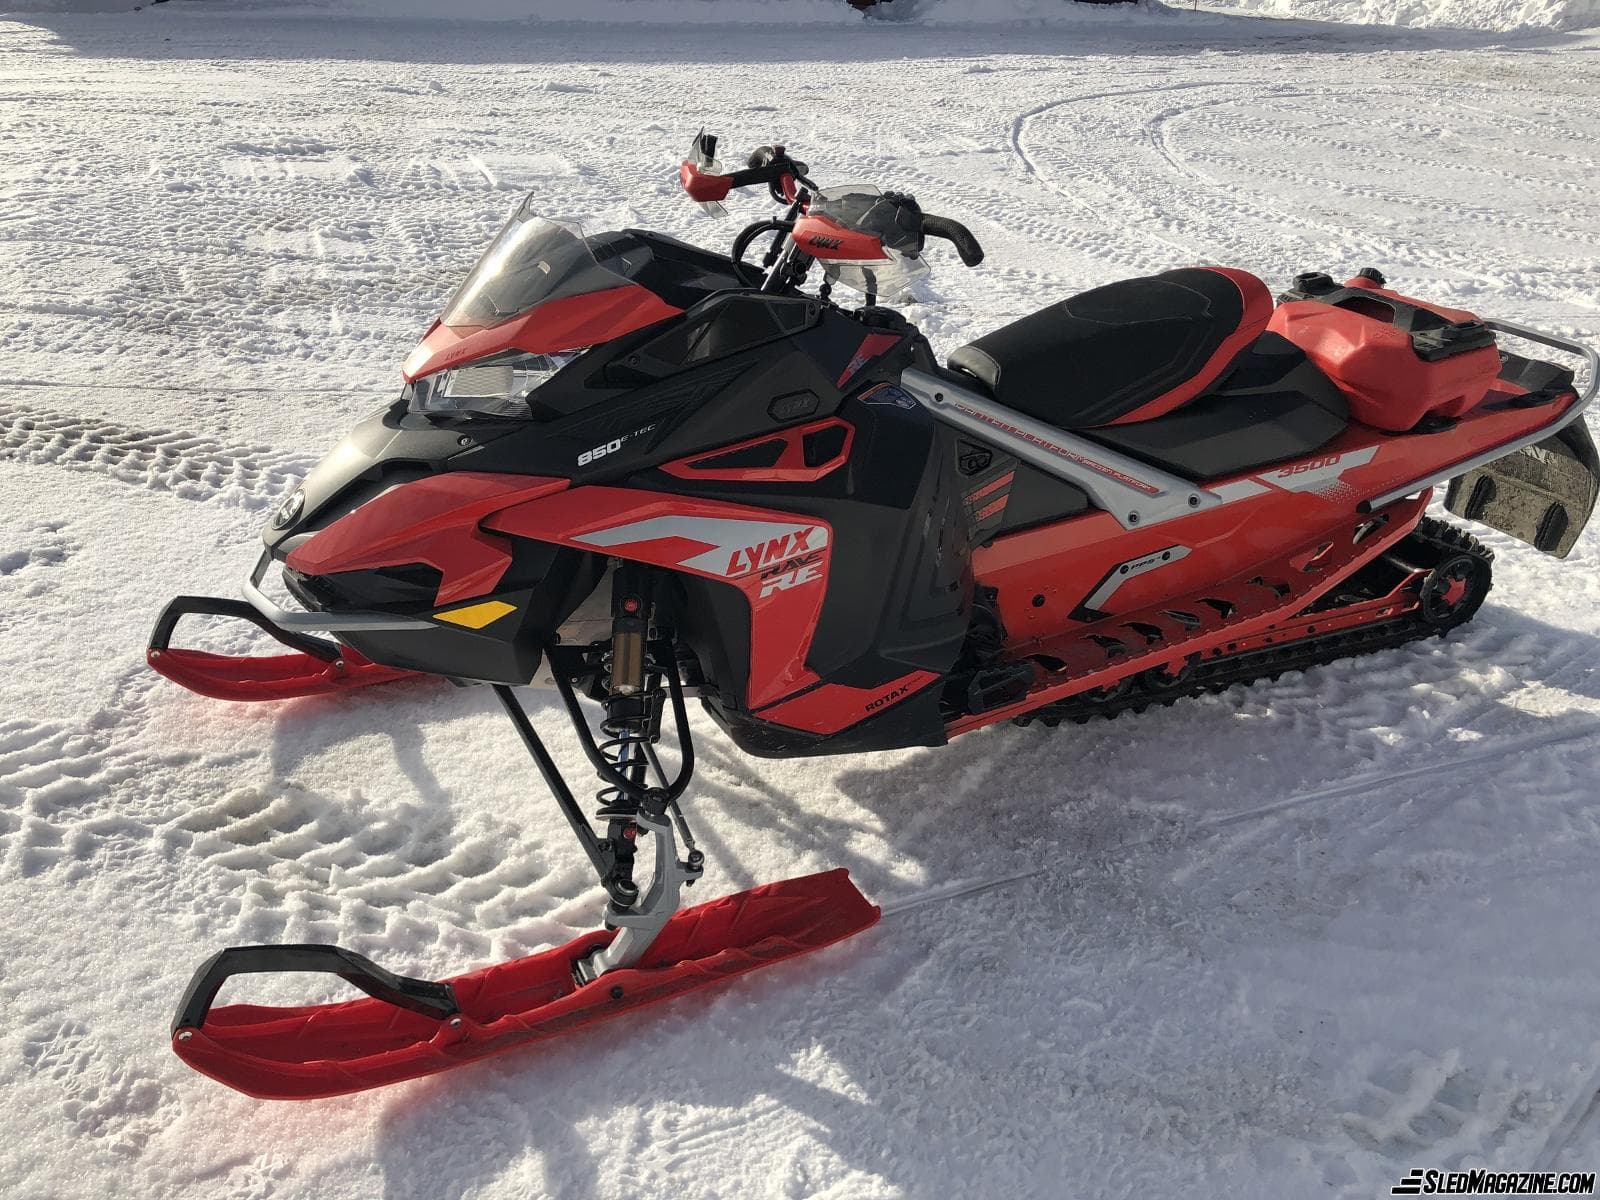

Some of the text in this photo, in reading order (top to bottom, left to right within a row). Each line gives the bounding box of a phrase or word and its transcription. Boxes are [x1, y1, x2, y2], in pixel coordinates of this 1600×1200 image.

[577, 423, 657, 467] 850 E-TEC
[1277, 455, 1341, 478] 3500
[725, 526, 815, 577] LYNX
[759, 560, 824, 599] RE
[864, 684, 908, 712] ROTAX
